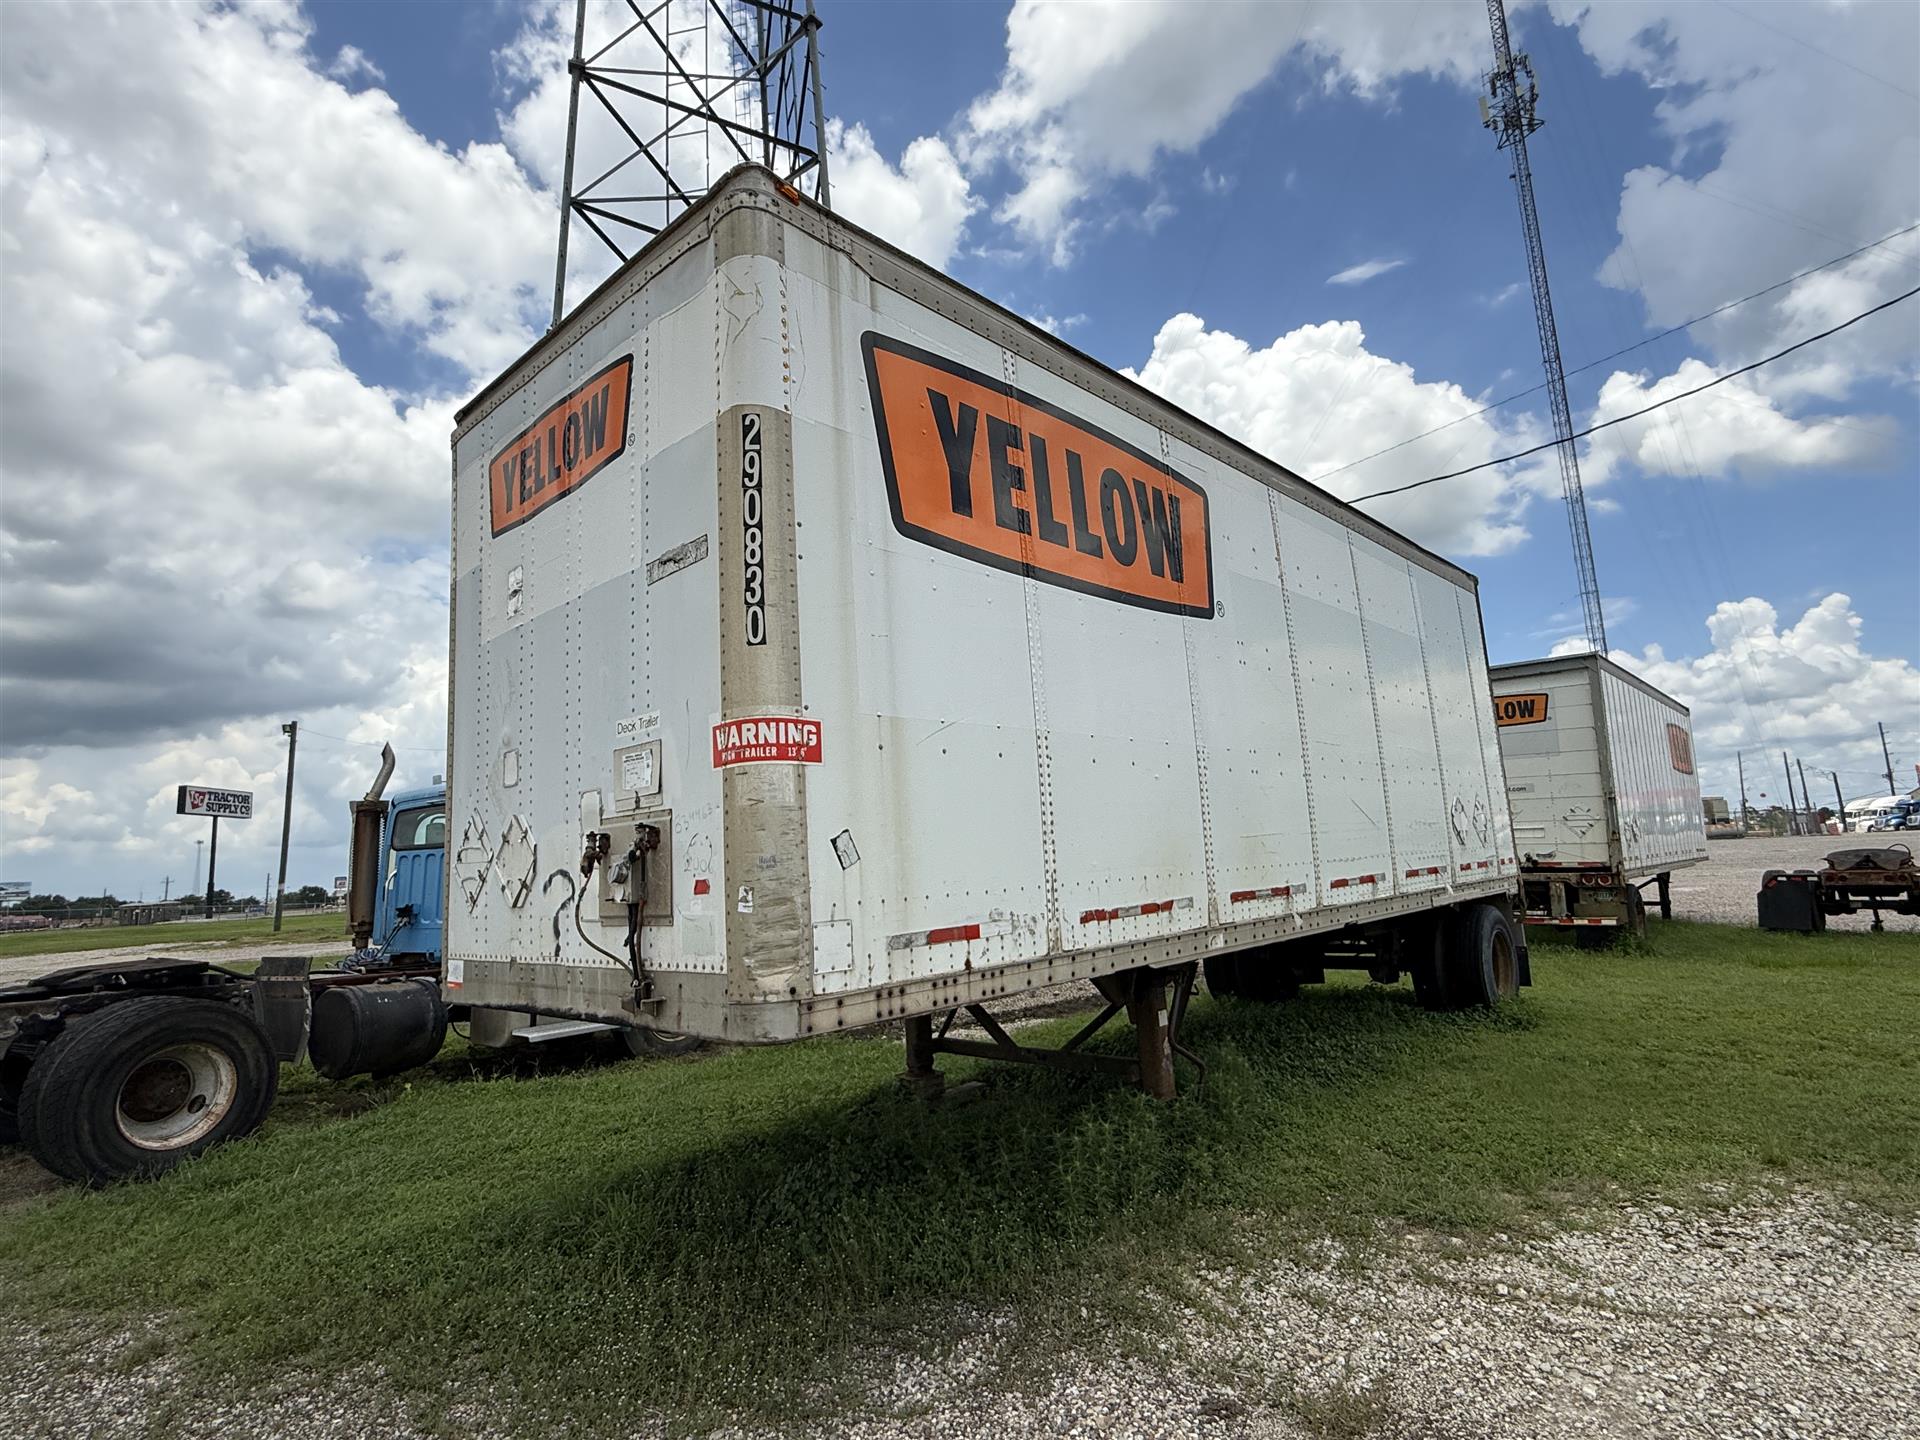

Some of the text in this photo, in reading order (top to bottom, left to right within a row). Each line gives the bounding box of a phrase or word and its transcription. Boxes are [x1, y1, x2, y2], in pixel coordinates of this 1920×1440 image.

[502, 383, 610, 514] YELLOW
[926, 387, 1184, 583] YELLOW
[743, 413, 765, 644] 290830
[715, 721, 818, 752] WARNING
[741, 746, 777, 759] TRAILER
[206, 802, 239, 814] SUPPLY
[207, 791, 250, 804] TRACTOR
